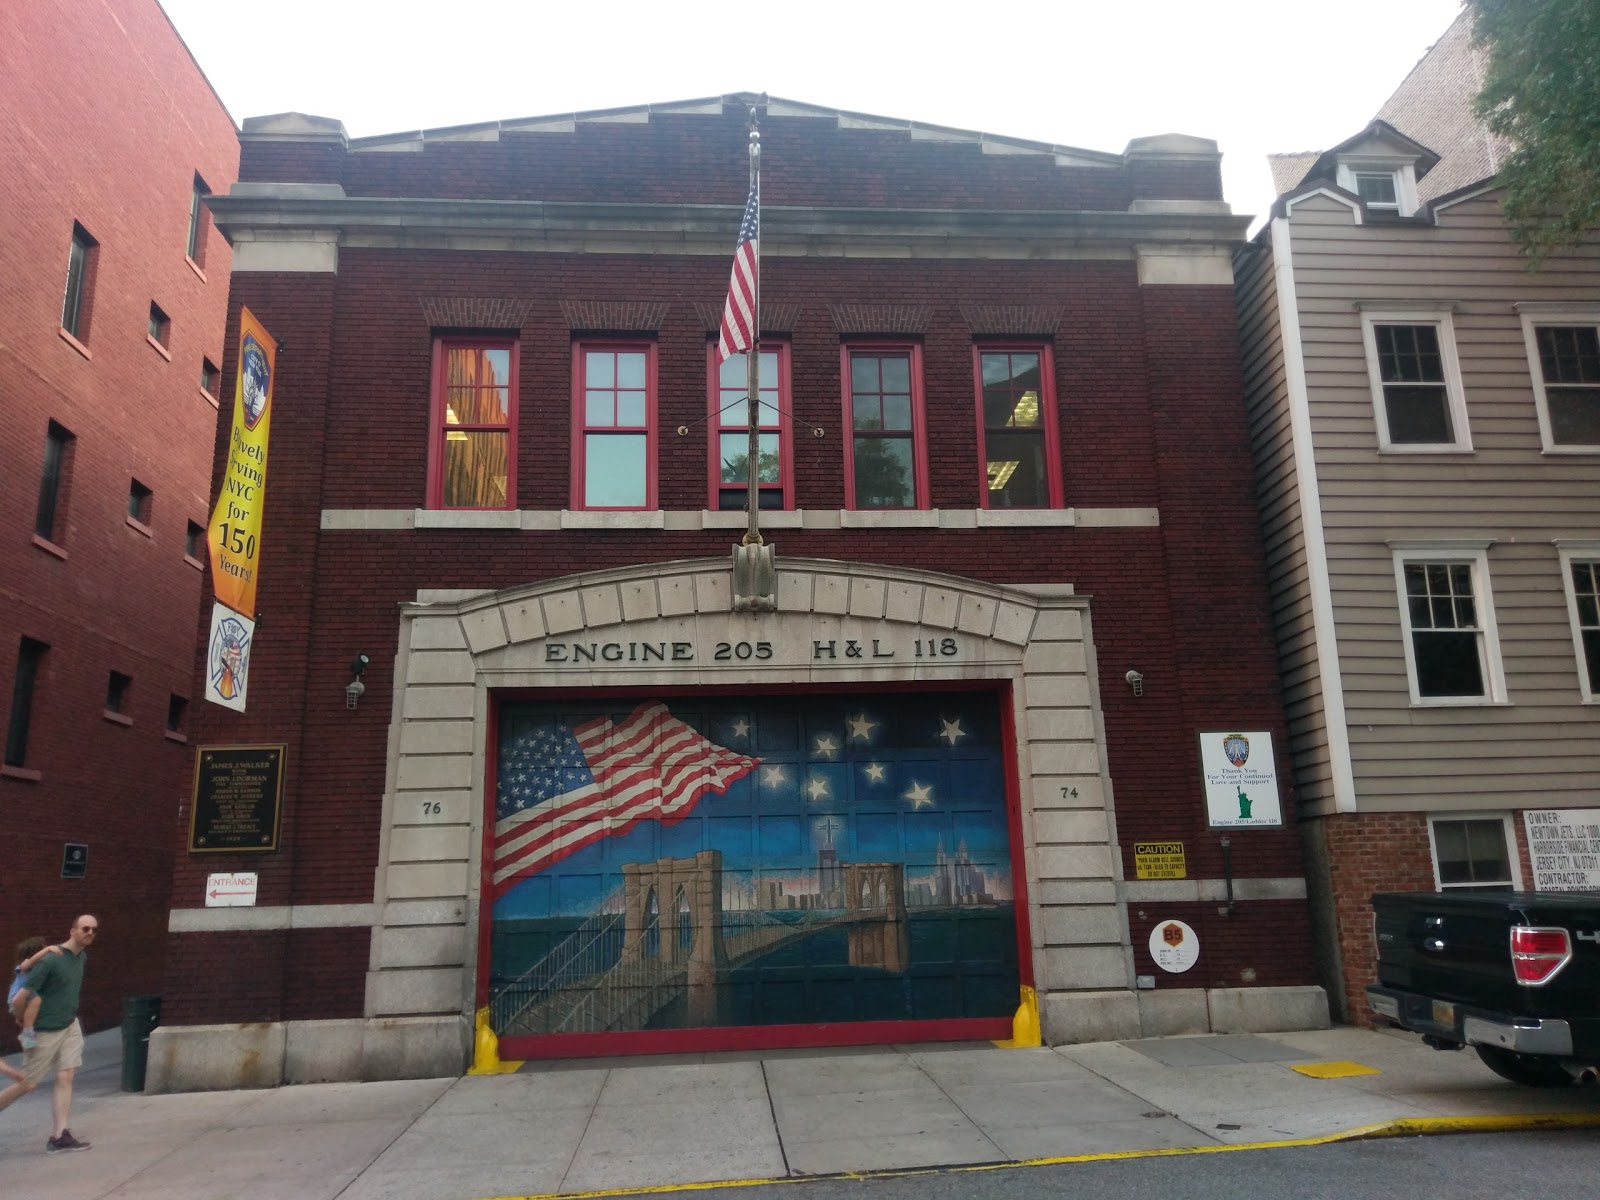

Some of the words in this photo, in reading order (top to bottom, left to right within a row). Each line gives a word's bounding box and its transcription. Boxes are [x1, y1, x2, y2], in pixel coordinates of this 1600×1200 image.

[226, 477, 255, 501] NYC
[227, 501, 249, 521] for
[219, 522, 255, 560] 150
[219, 554, 252, 584] Years!
[545, 642, 694, 662] ENGINE
[714, 641, 773, 660] 205
[914, 638, 958, 657] 118
[1060, 786, 1078, 799] 74
[423, 801, 441, 815] 76
[1528, 812, 1561, 824] OWNER:
[1530, 825, 1560, 839] NEWTOWN
[1575, 824, 1586, 839] LLC
[1137, 844, 1181, 854] CAUTION
[1536, 856, 1557, 870] JERSEY
[1573, 855, 1581, 870] NJ
[208, 877, 256, 886] ENTRANCE
[1538, 872, 1589, 885] CONTRACTOR:
[1164, 930, 1182, 940] B5
